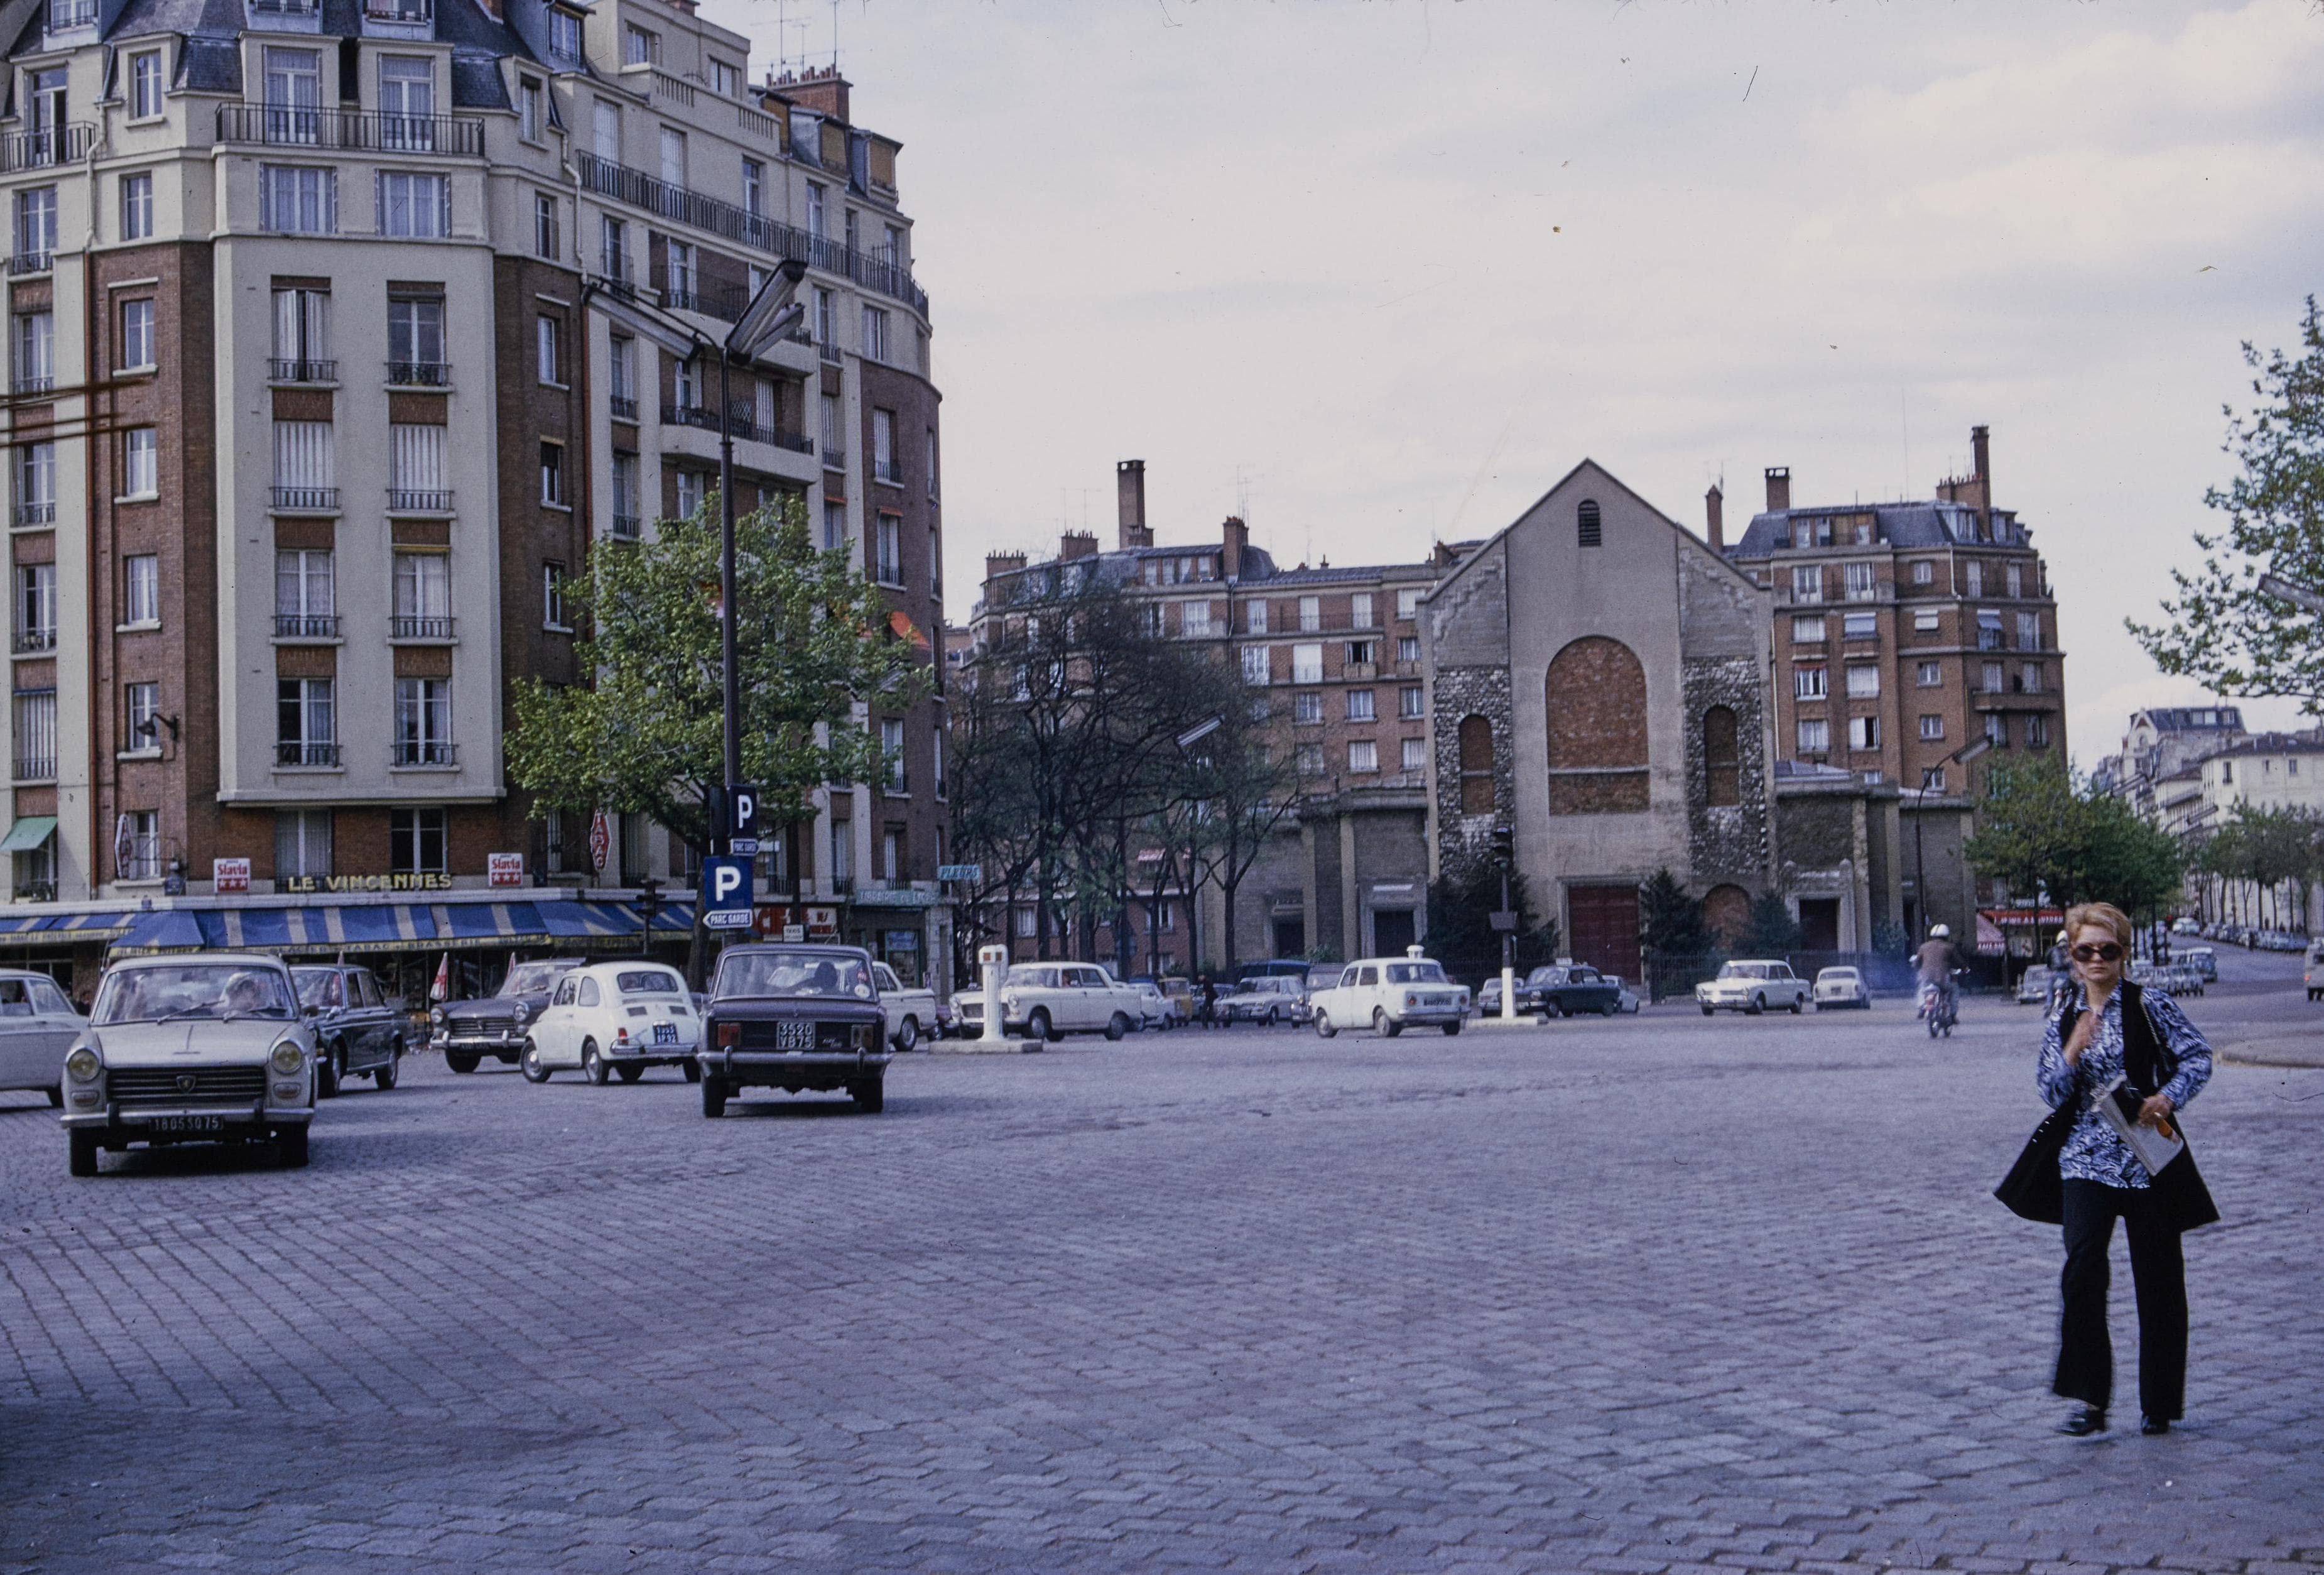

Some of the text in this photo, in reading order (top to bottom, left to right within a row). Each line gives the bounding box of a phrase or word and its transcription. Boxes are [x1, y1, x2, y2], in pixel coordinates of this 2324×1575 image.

[738, 794, 752, 829] P
[594, 812, 605, 867] TABAC
[492, 858, 521, 869] Slavia
[218, 864, 247, 875] Slavia
[288, 873, 452, 893] LE VINCENNES
[715, 866, 741, 902] P
[710, 914, 727, 925] PARC
[346, 944, 389, 952] TABAC
[780, 1025, 812, 1035] 3520
